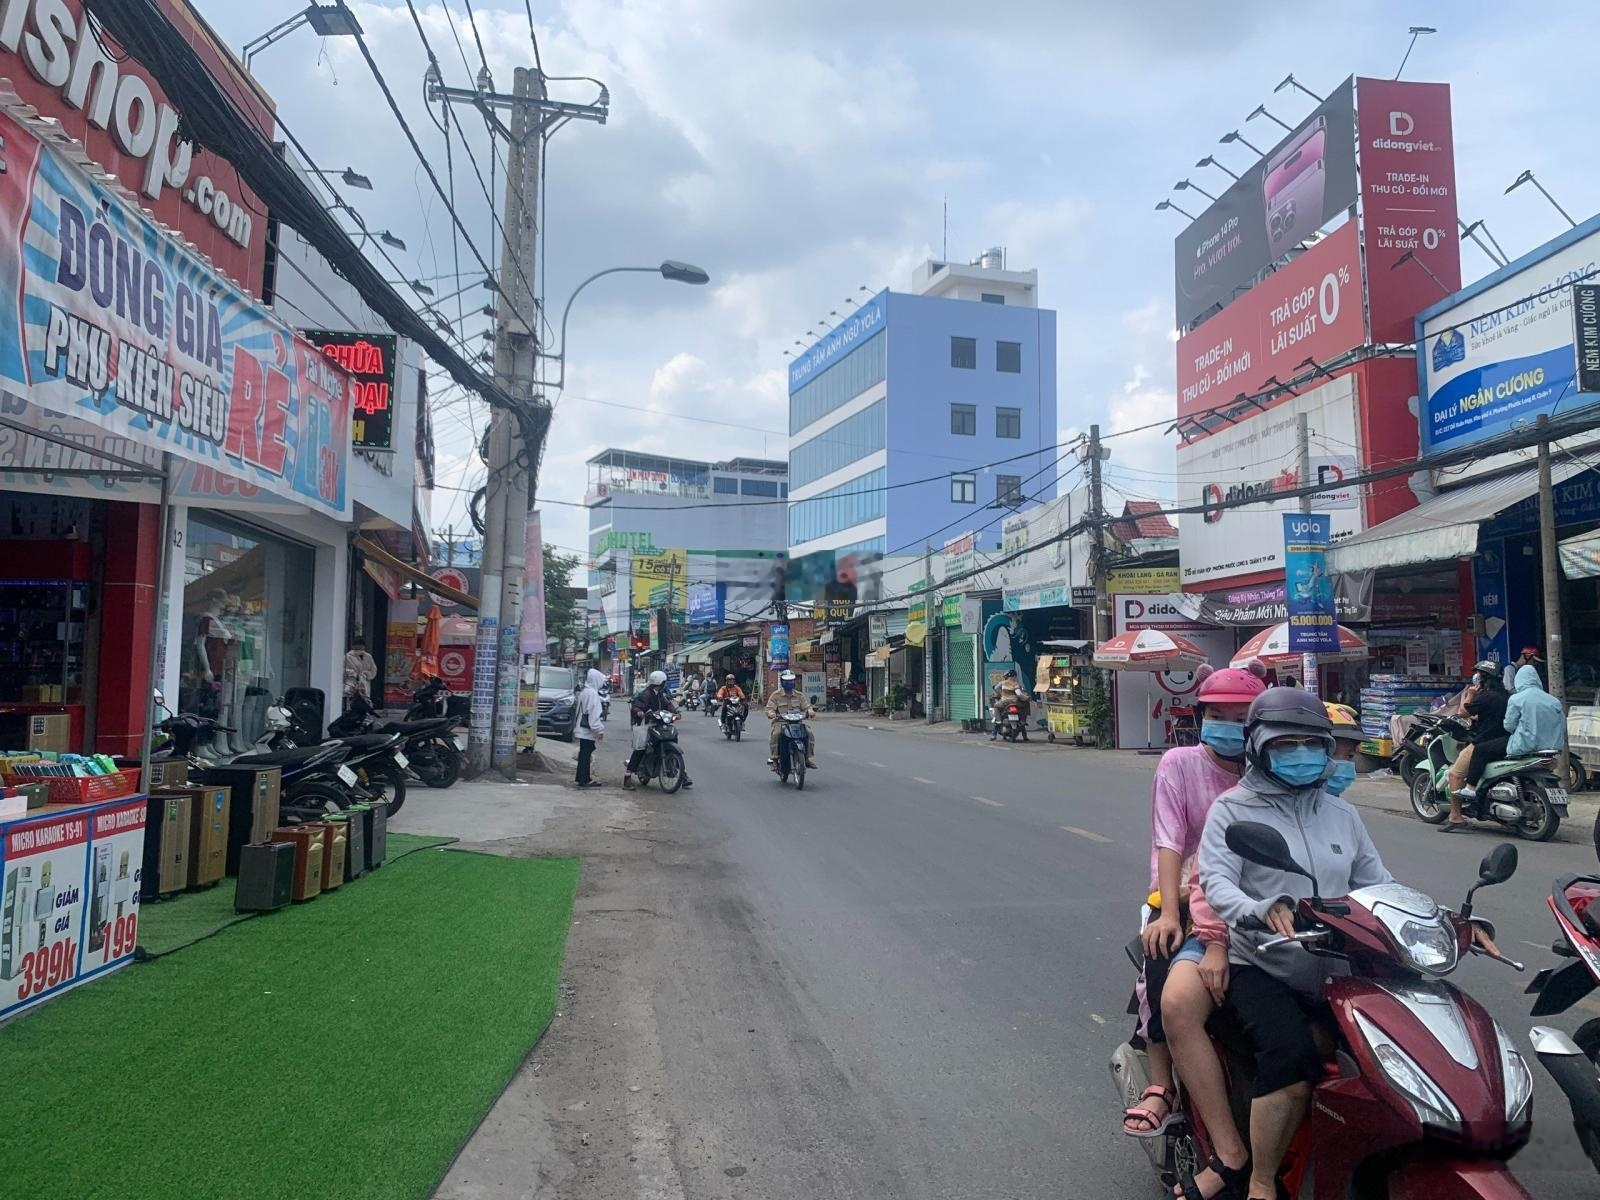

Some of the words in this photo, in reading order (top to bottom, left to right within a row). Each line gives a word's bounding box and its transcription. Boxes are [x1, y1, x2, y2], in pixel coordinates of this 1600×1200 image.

[1371, 184, 1390, 193] THU
[1430, 186, 1448, 196] MỚI
[1385, 173, 1430, 183] TRADE-IN
[1228, 216, 1239, 232] Pro
[1377, 225, 1396, 236] TRẢ
[1398, 226, 1418, 236] GÓP
[1377, 238, 1393, 248] LÃI
[1395, 239, 1419, 249] SUẤT
[57, 197, 164, 341] ĐỒNG
[174, 281, 225, 374] GIÁ
[1270, 297, 1291, 327] TRẢ
[1292, 287, 1315, 314] GÓP
[826, 335, 842, 359] ANH
[860, 306, 881, 332] YOLA
[1271, 331, 1288, 356] LÃI
[1288, 310, 1317, 345] SUẤT
[1583, 326, 1599, 347] KIM
[1194, 337, 1233, 374] TRADE-IN
[44, 304, 112, 399] PHỤ
[114, 337, 177, 430] KIỆN
[178, 368, 227, 448] SIÊU
[1182, 383, 1198, 404] THU
[1233, 350, 1251, 376] MỚI
[225, 333, 298, 478] RẺ
[1434, 411, 1448, 424] ĐẠI
[1448, 402, 1458, 418] LÝ
[1459, 386, 1494, 415] NGÂN
[1495, 367, 1546, 400] CƯƠNG
[1291, 518, 1321, 537] yola
[607, 531, 656, 550] HOTEL
[1256, 604, 1273, 619] Mới
[97, 814, 116, 833] MICRO
[11, 832, 35, 853] MICRO
[35, 823, 65, 847] KARAOKE
[55, 884, 79, 909] GIẢM
[54, 911, 70, 934] GIÁ
